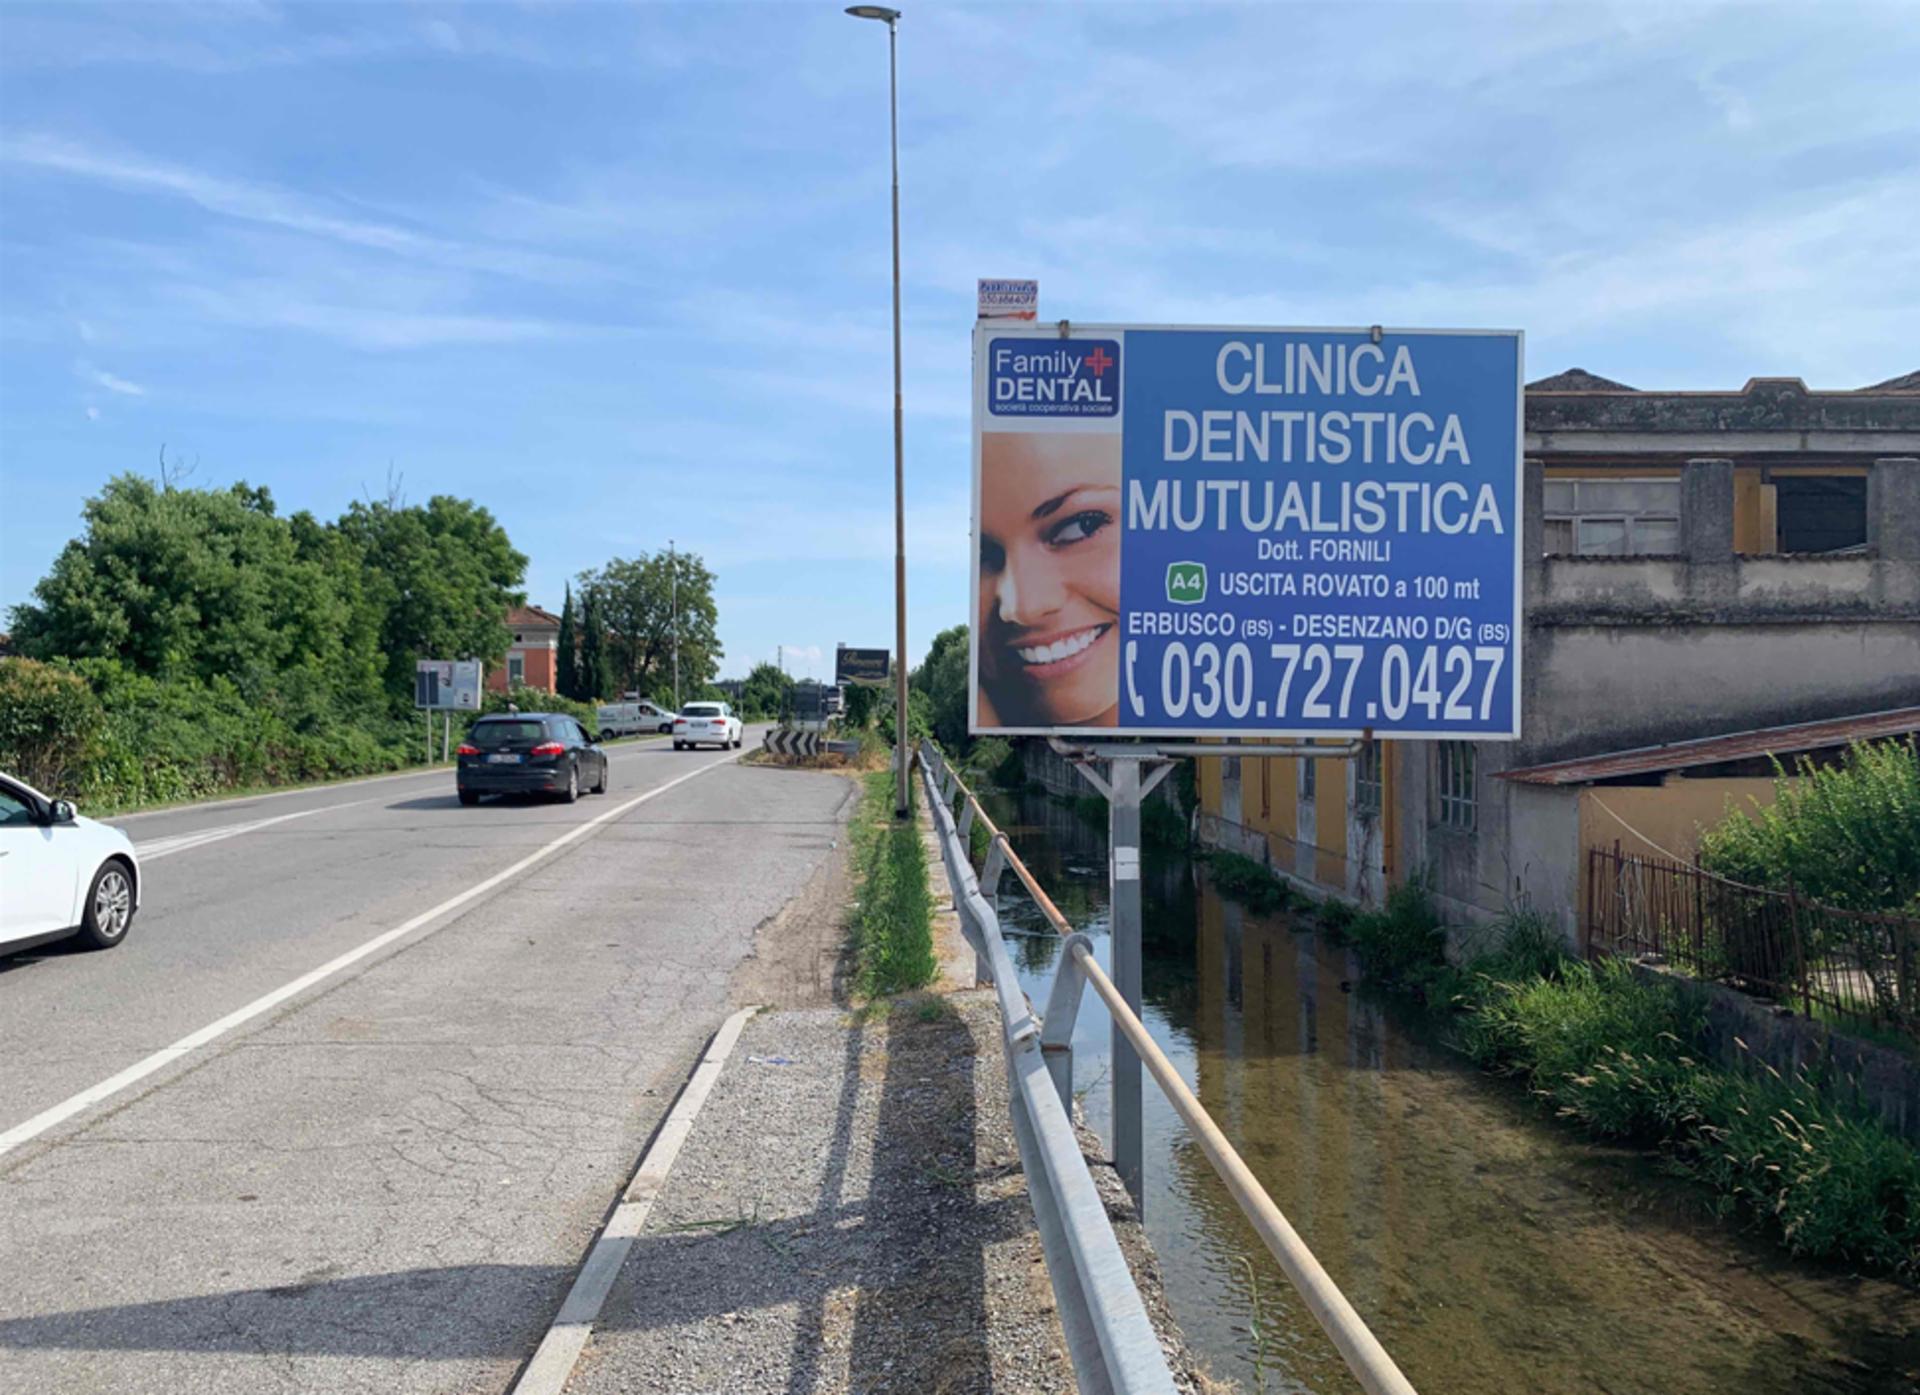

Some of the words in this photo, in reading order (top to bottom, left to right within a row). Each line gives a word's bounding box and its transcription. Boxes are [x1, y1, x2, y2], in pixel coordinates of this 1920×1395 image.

[996, 349, 1082, 379] Family
[1217, 341, 1420, 396] CLINICA
[996, 378, 1113, 402] DENTAL
[1029, 404, 1080, 414] cooperativa
[1082, 404, 1113, 413] sociale
[1164, 410, 1471, 465] DENTISTICA
[1128, 479, 1504, 535] MUTUALISTICA
[1257, 538, 1304, 562] Dott.
[1309, 539, 1391, 562] FORNILI
[1171, 574, 1202, 591] A4
[1220, 572, 1298, 598] USCITA
[1302, 573, 1390, 599] ROVATO
[1394, 580, 1408, 599] a
[1413, 576, 1449, 600] 100
[1454, 579, 1481, 600] mt
[1128, 611, 1236, 637] ERBUSCO
[1241, 618, 1274, 638] (BS)
[1293, 614, 1429, 640] DESENZANO
[1435, 616, 1473, 641] D/G
[1477, 622, 1510, 643] (BS)
[1161, 641, 1505, 721] 030.727.0427
